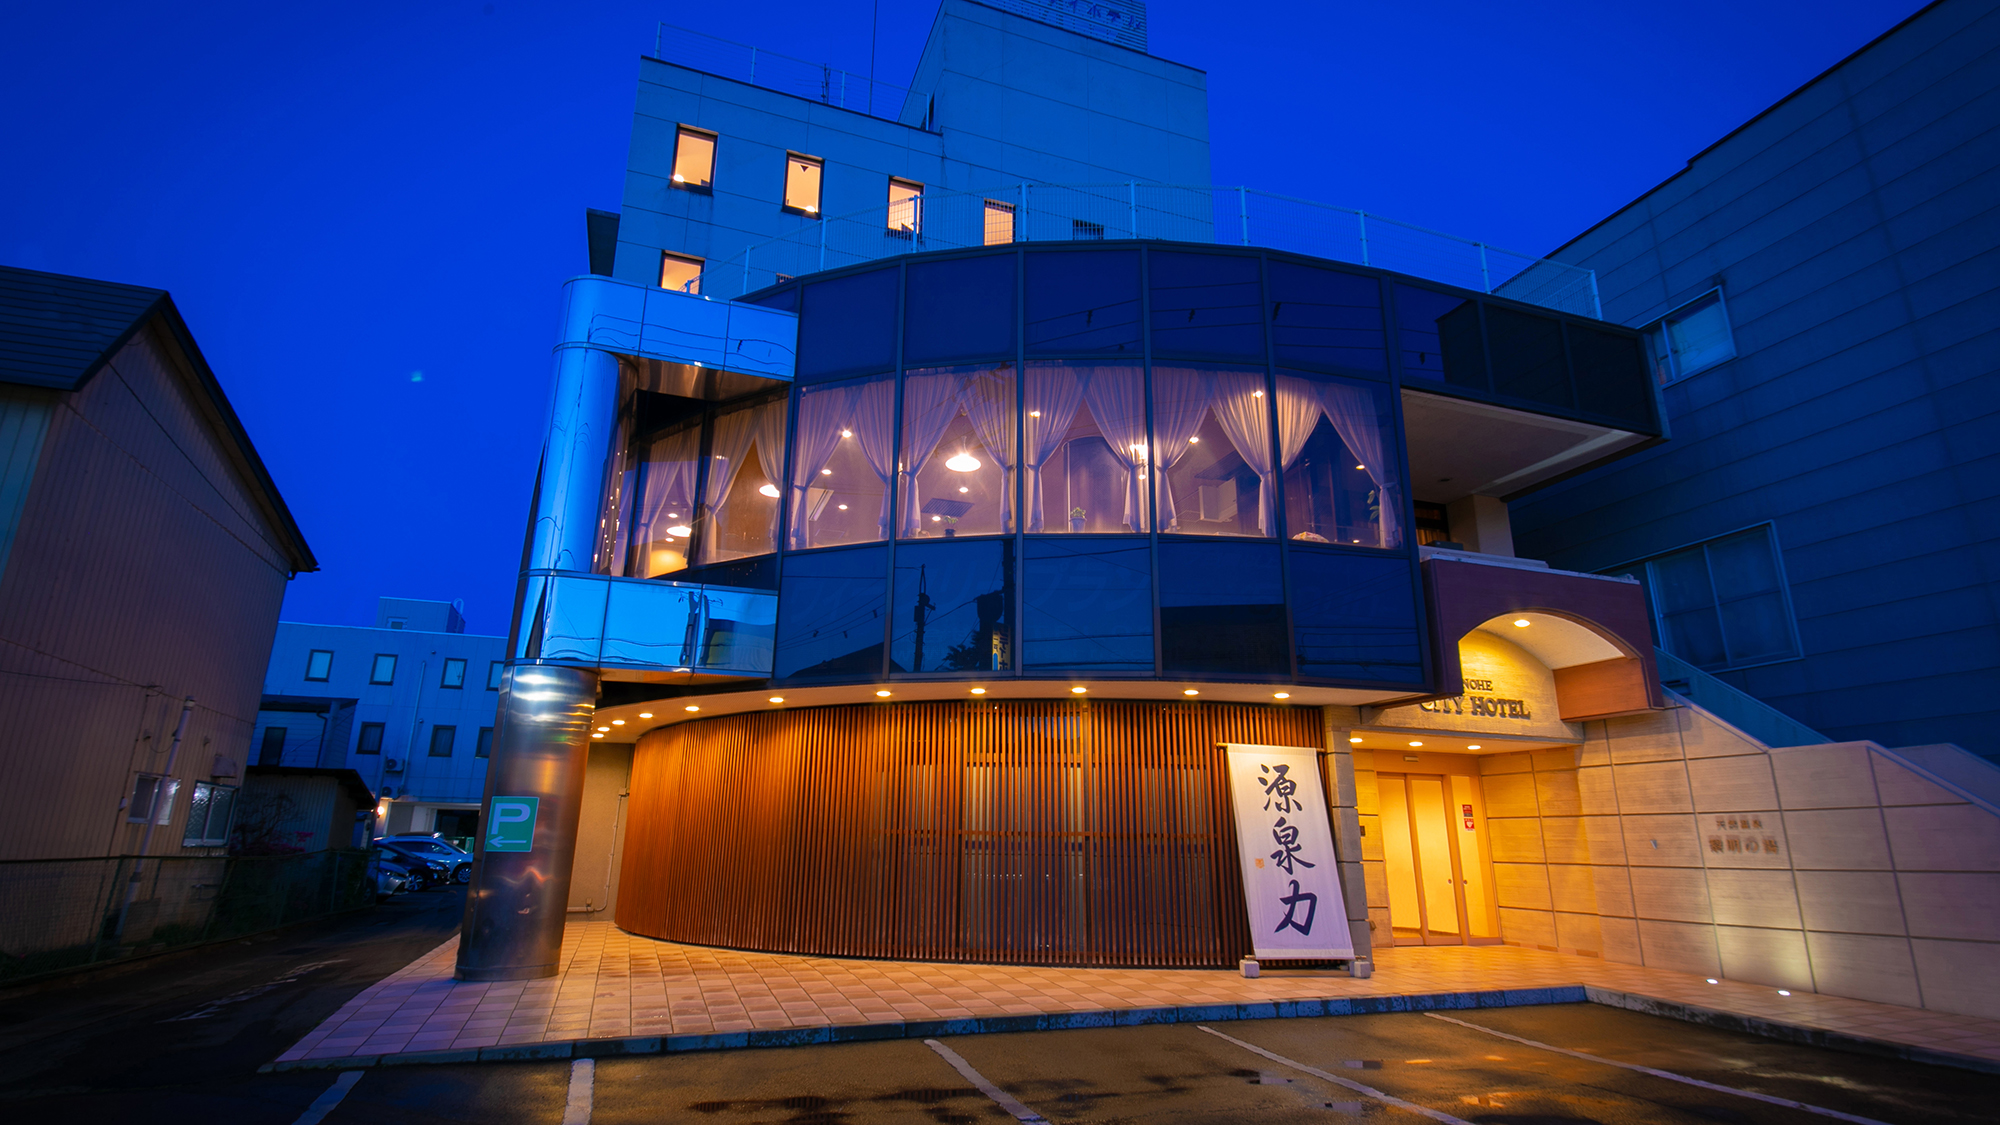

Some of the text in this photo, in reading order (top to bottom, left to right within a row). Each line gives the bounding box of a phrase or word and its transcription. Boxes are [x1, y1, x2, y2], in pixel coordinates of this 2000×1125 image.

[1470, 695, 1531, 720] HOTEL
[490, 802, 531, 835] P
[1257, 763, 1318, 936] 源泉力
